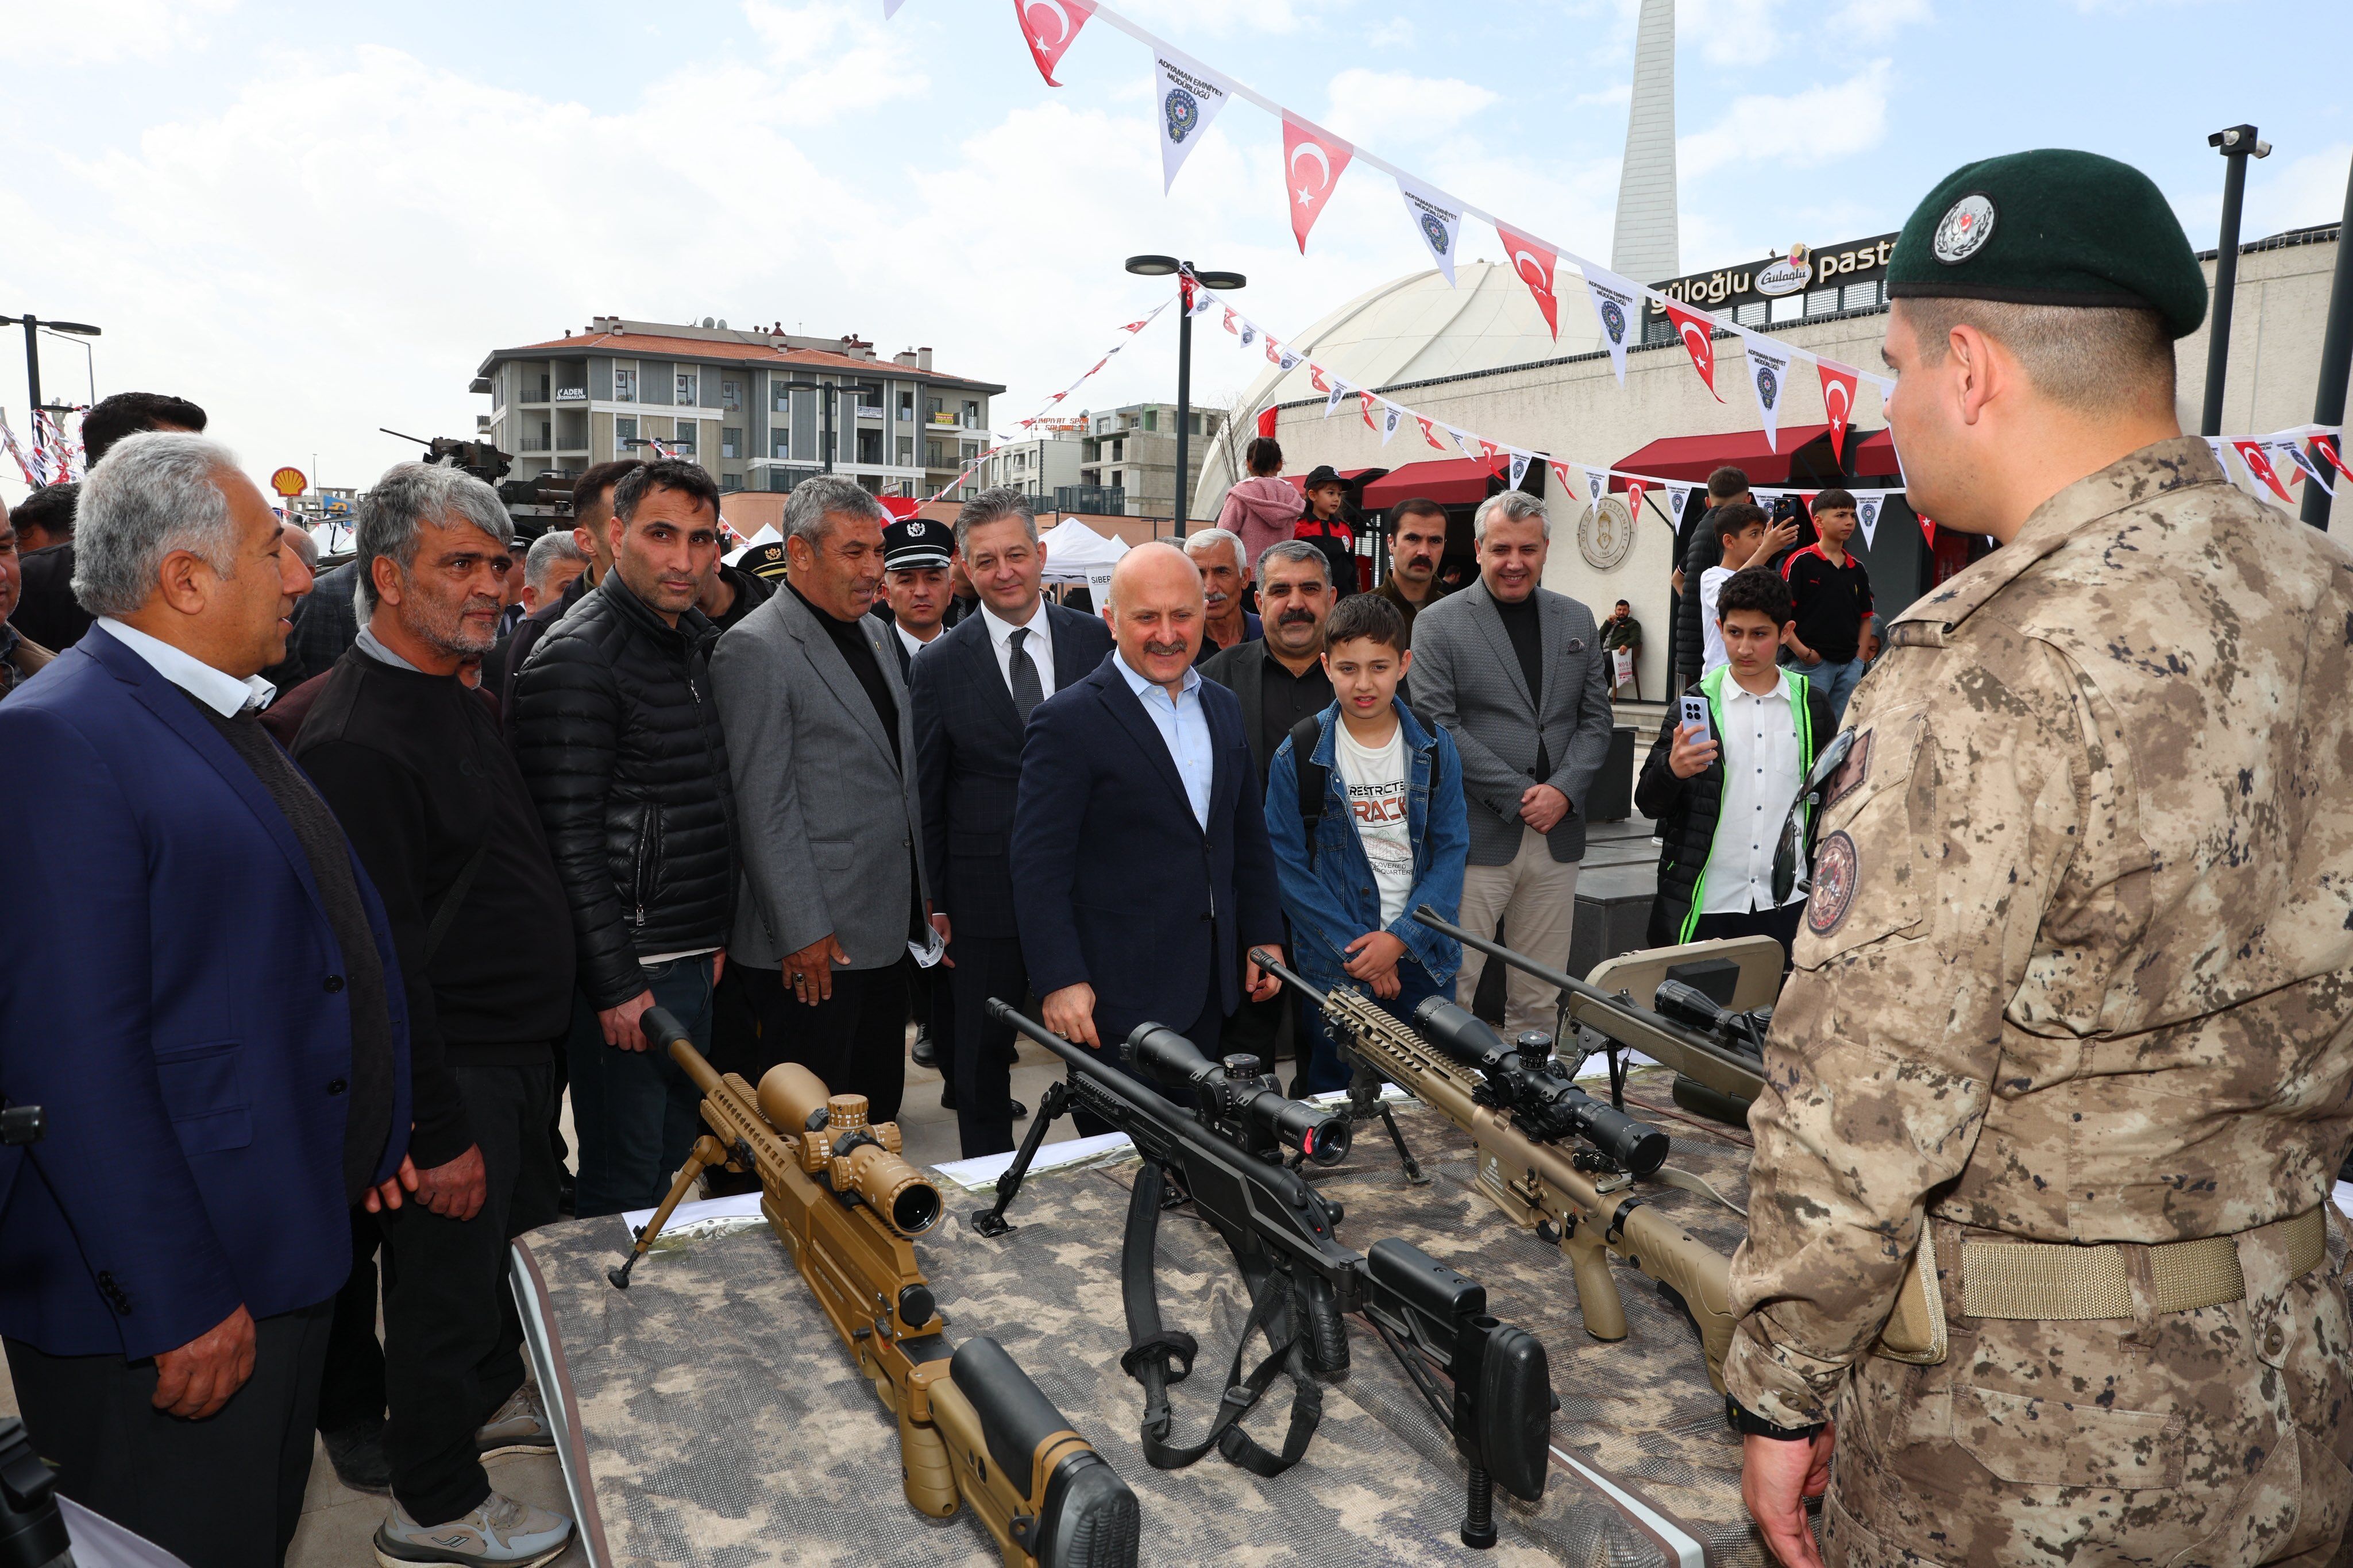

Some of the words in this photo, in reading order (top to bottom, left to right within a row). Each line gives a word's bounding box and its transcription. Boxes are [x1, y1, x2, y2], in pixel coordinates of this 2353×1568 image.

[1158, 59, 1193, 83] ADIYAMAN
[1193, 78, 1223, 97] EMNİYET
[1167, 72, 1210, 100] MÜDÜRLÜĞÜ
[1175, 90, 1194, 106] POLİS
[1405, 191, 1434, 209] ADIYAMAN
[1434, 205, 1457, 221] EMNİYET
[1414, 201, 1449, 222] MÜDÜRLÜĞÜ
[1650, 271, 1749, 315] güloğlu
[1819, 241, 1895, 283] past
[1588, 280, 1613, 295] ADIYAMAN
[1613, 291, 1633, 303] EMNİYET
[1596, 290, 1626, 306] MÜDÜRLÜĞÜ
[1748, 349, 1769, 360] ADIYAMAN
[1769, 356, 1787, 366] EMNİYET
[1754, 357, 1779, 370] MÜDÜRLÜĞÜ
[1222, 1126, 1233, 1137] Milmont
[1284, 1130, 1298, 1141] KAHLES
